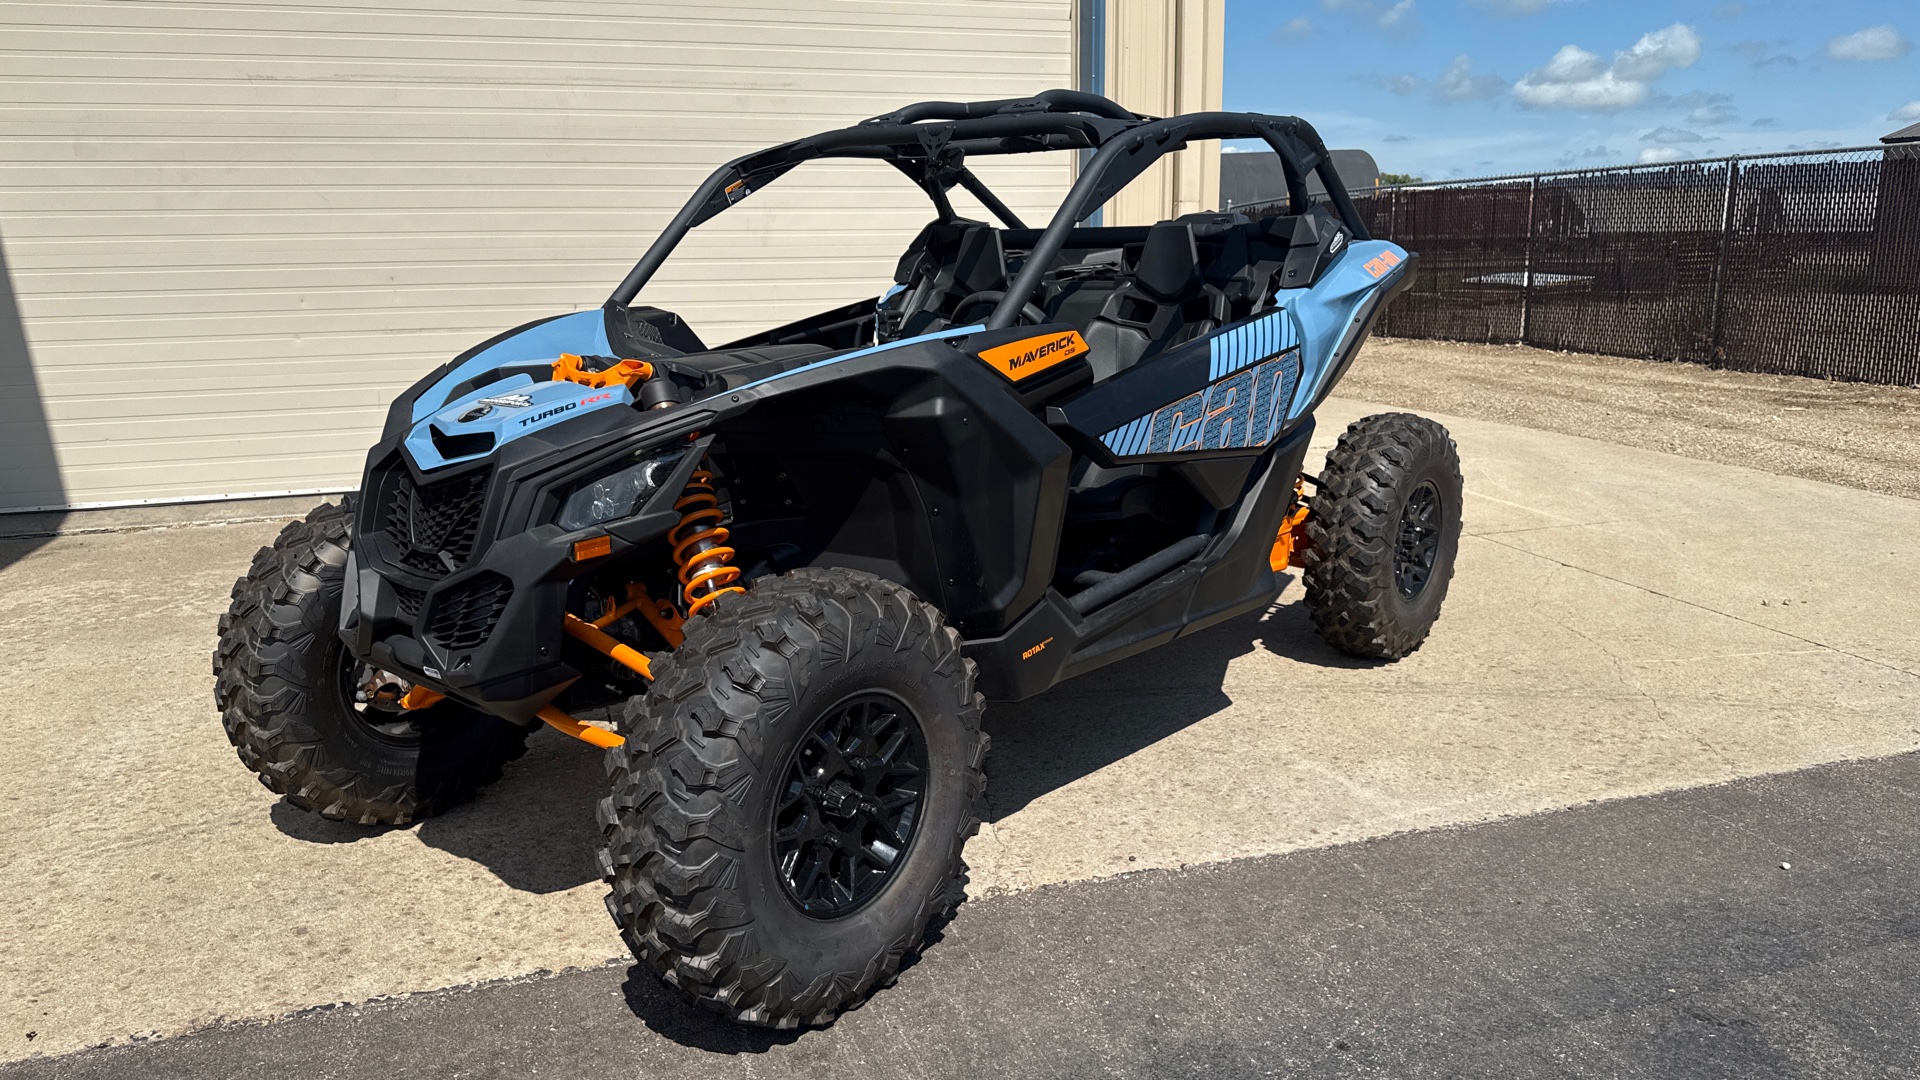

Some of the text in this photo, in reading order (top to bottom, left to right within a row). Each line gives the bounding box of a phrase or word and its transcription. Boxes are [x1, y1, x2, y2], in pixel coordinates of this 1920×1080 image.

[1008, 333, 1076, 371] MAVERICK
[518, 393, 613, 427] TURBO RR
[1022, 642, 1046, 660] ROTAX
